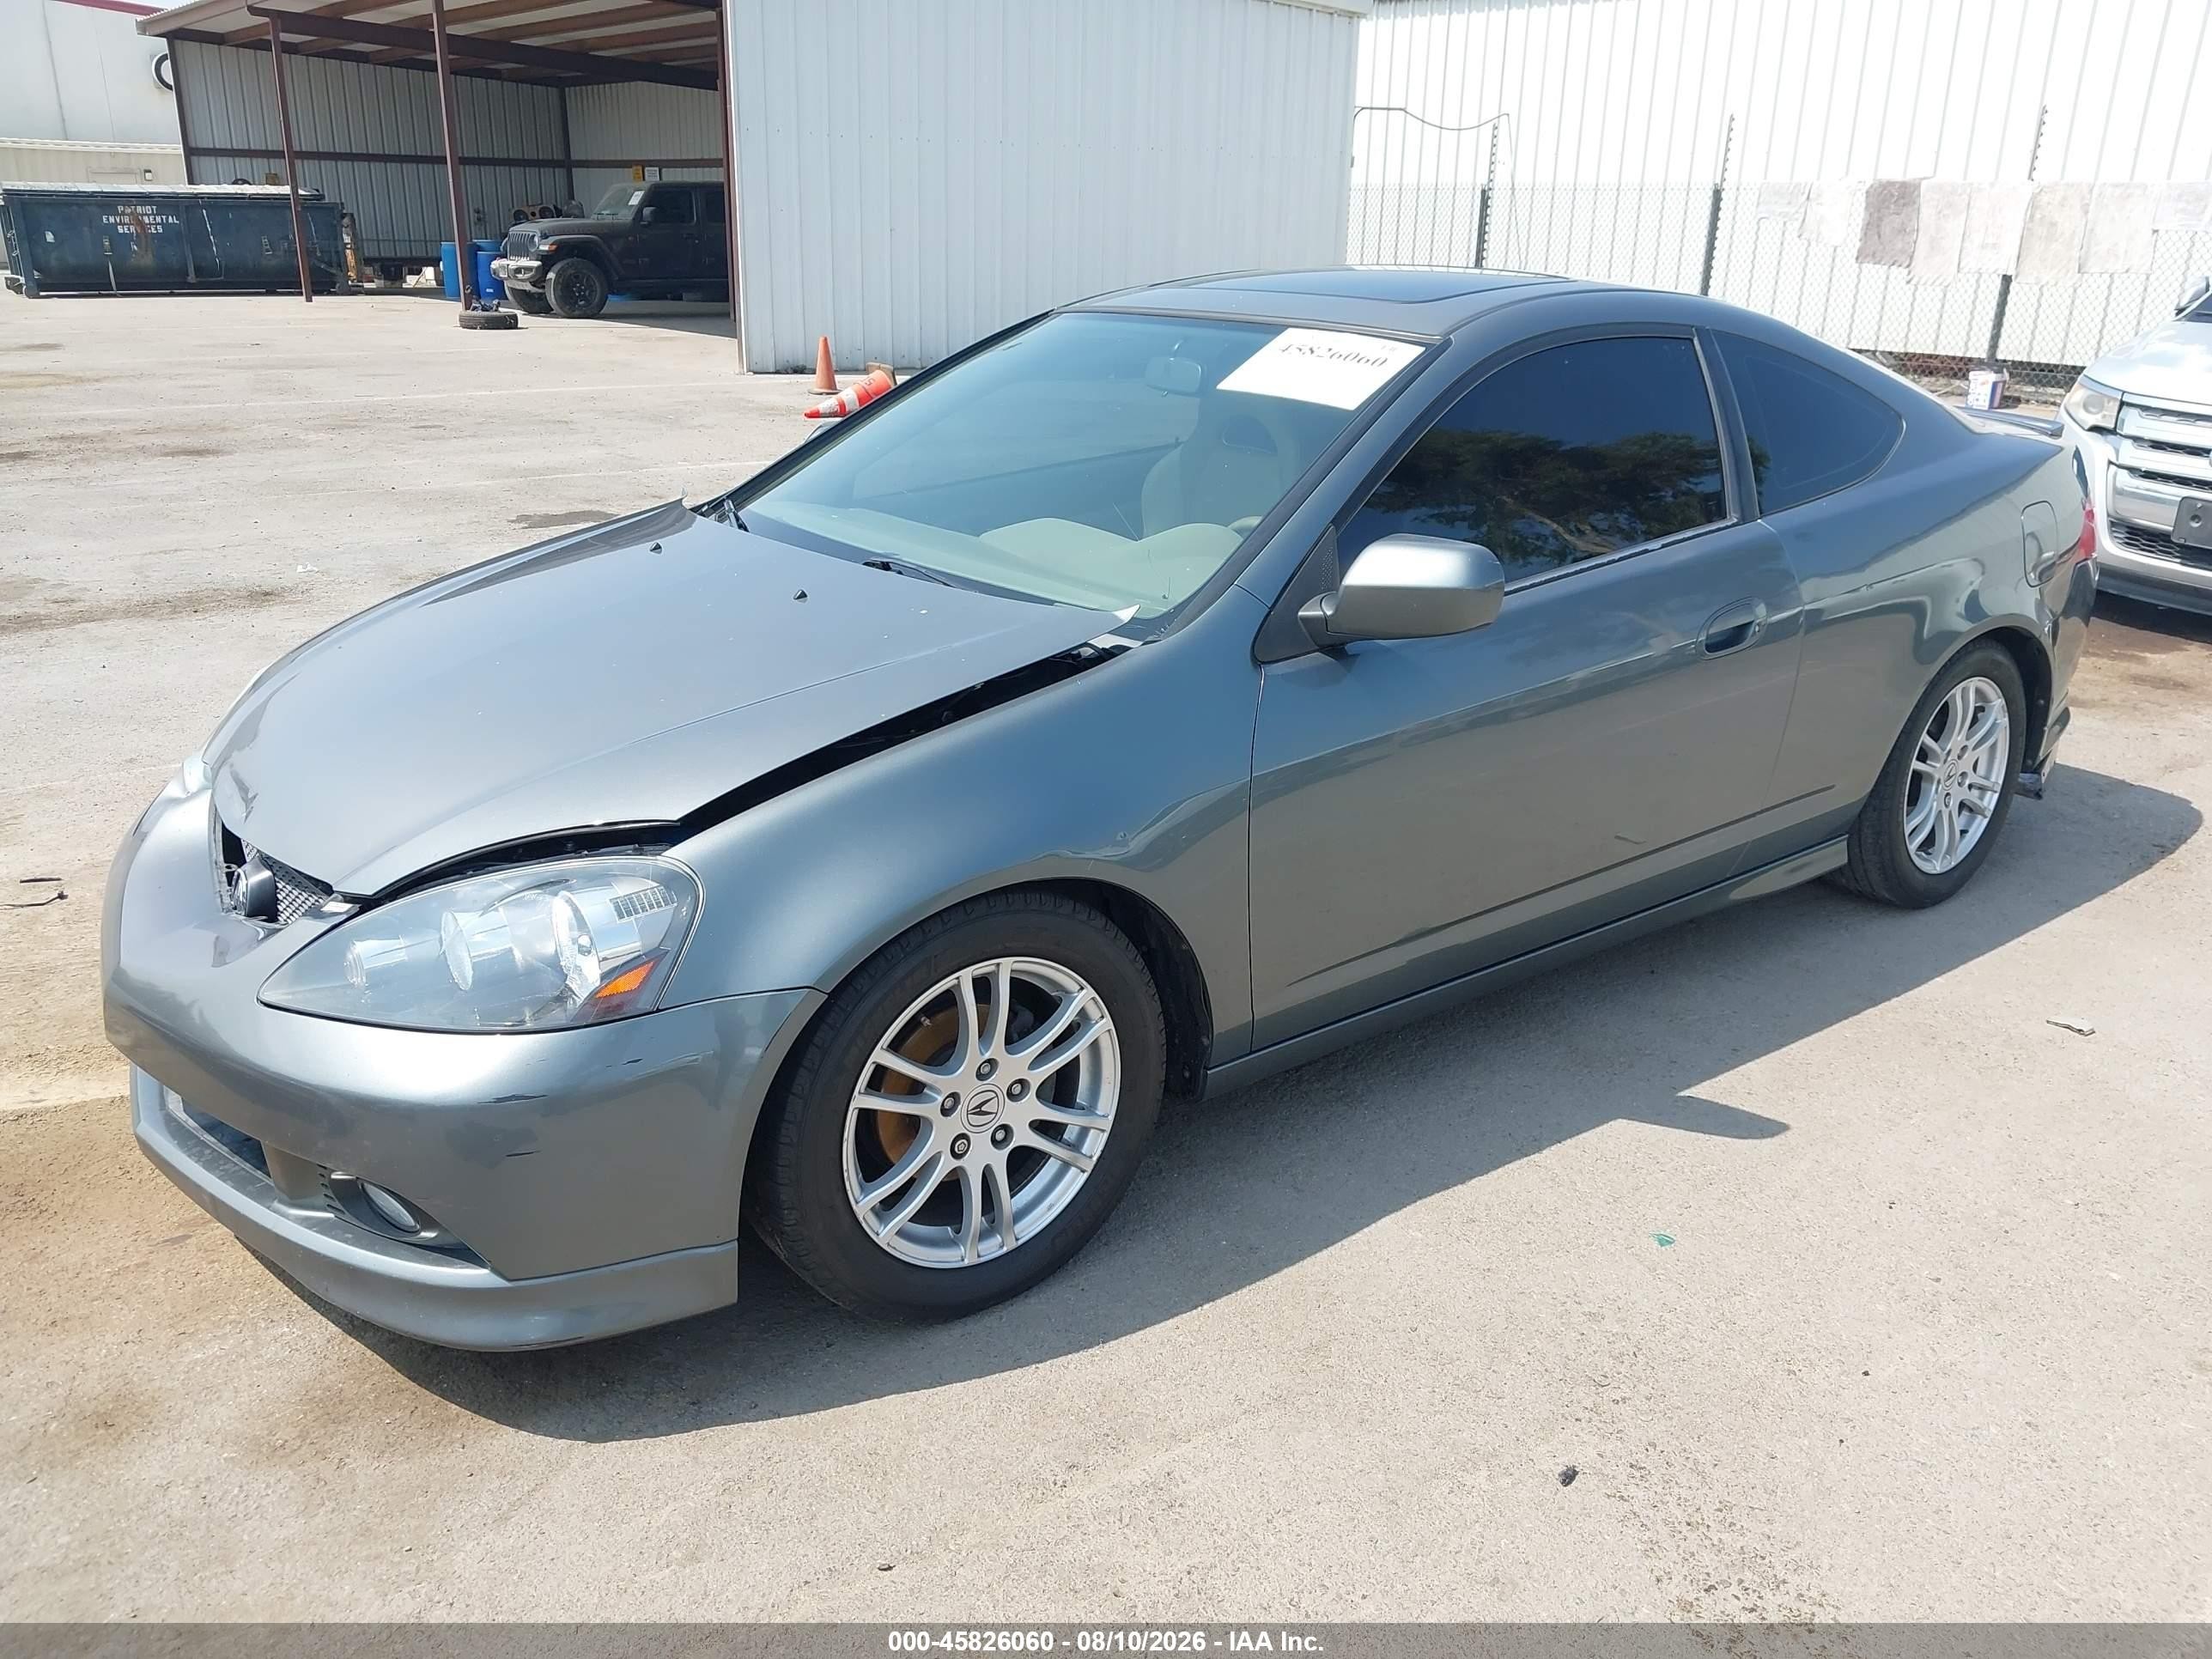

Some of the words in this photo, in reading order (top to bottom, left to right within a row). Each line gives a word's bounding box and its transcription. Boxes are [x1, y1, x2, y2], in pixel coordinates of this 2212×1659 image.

[117, 205, 158, 214] PATRIOT
[102, 215, 179, 224] ENVIRMENTAL
[117, 225, 163, 234] SERCES
